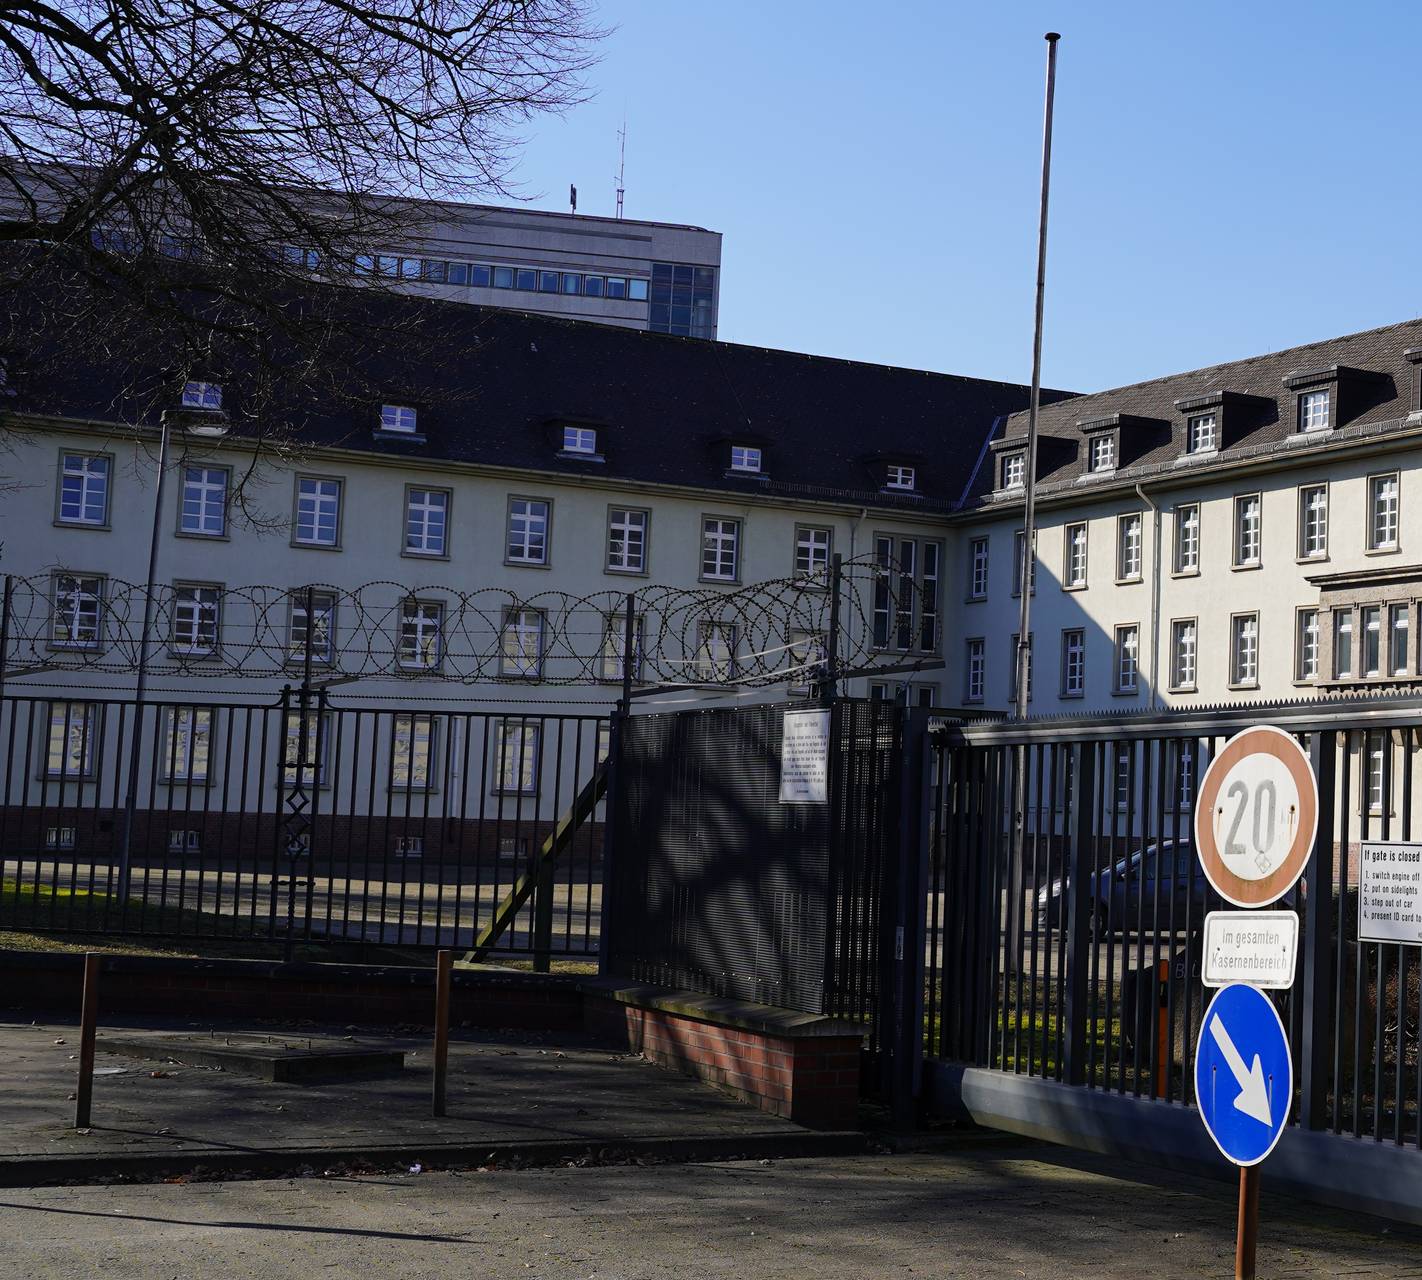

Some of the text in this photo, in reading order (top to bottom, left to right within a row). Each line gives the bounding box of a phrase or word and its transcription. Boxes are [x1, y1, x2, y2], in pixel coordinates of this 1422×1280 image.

[1224, 779, 1276, 854] 20
[1364, 849, 1420, 863] If gate is closed
[1365, 870, 1420, 882] 1. switch engine off
[1363, 883, 1418, 896] 2. put on sidelights
[1363, 896, 1413, 909] 3. step out of car
[1363, 910, 1369, 919] 4.
[1371, 911, 1392, 921] present
[1393, 911, 1400, 921] ID
[1401, 912, 1414, 922] card
[1415, 913, 1422, 923] to
[1236, 930, 1280, 949] gesamten
[1211, 952, 1287, 969] Kasernenbereich
